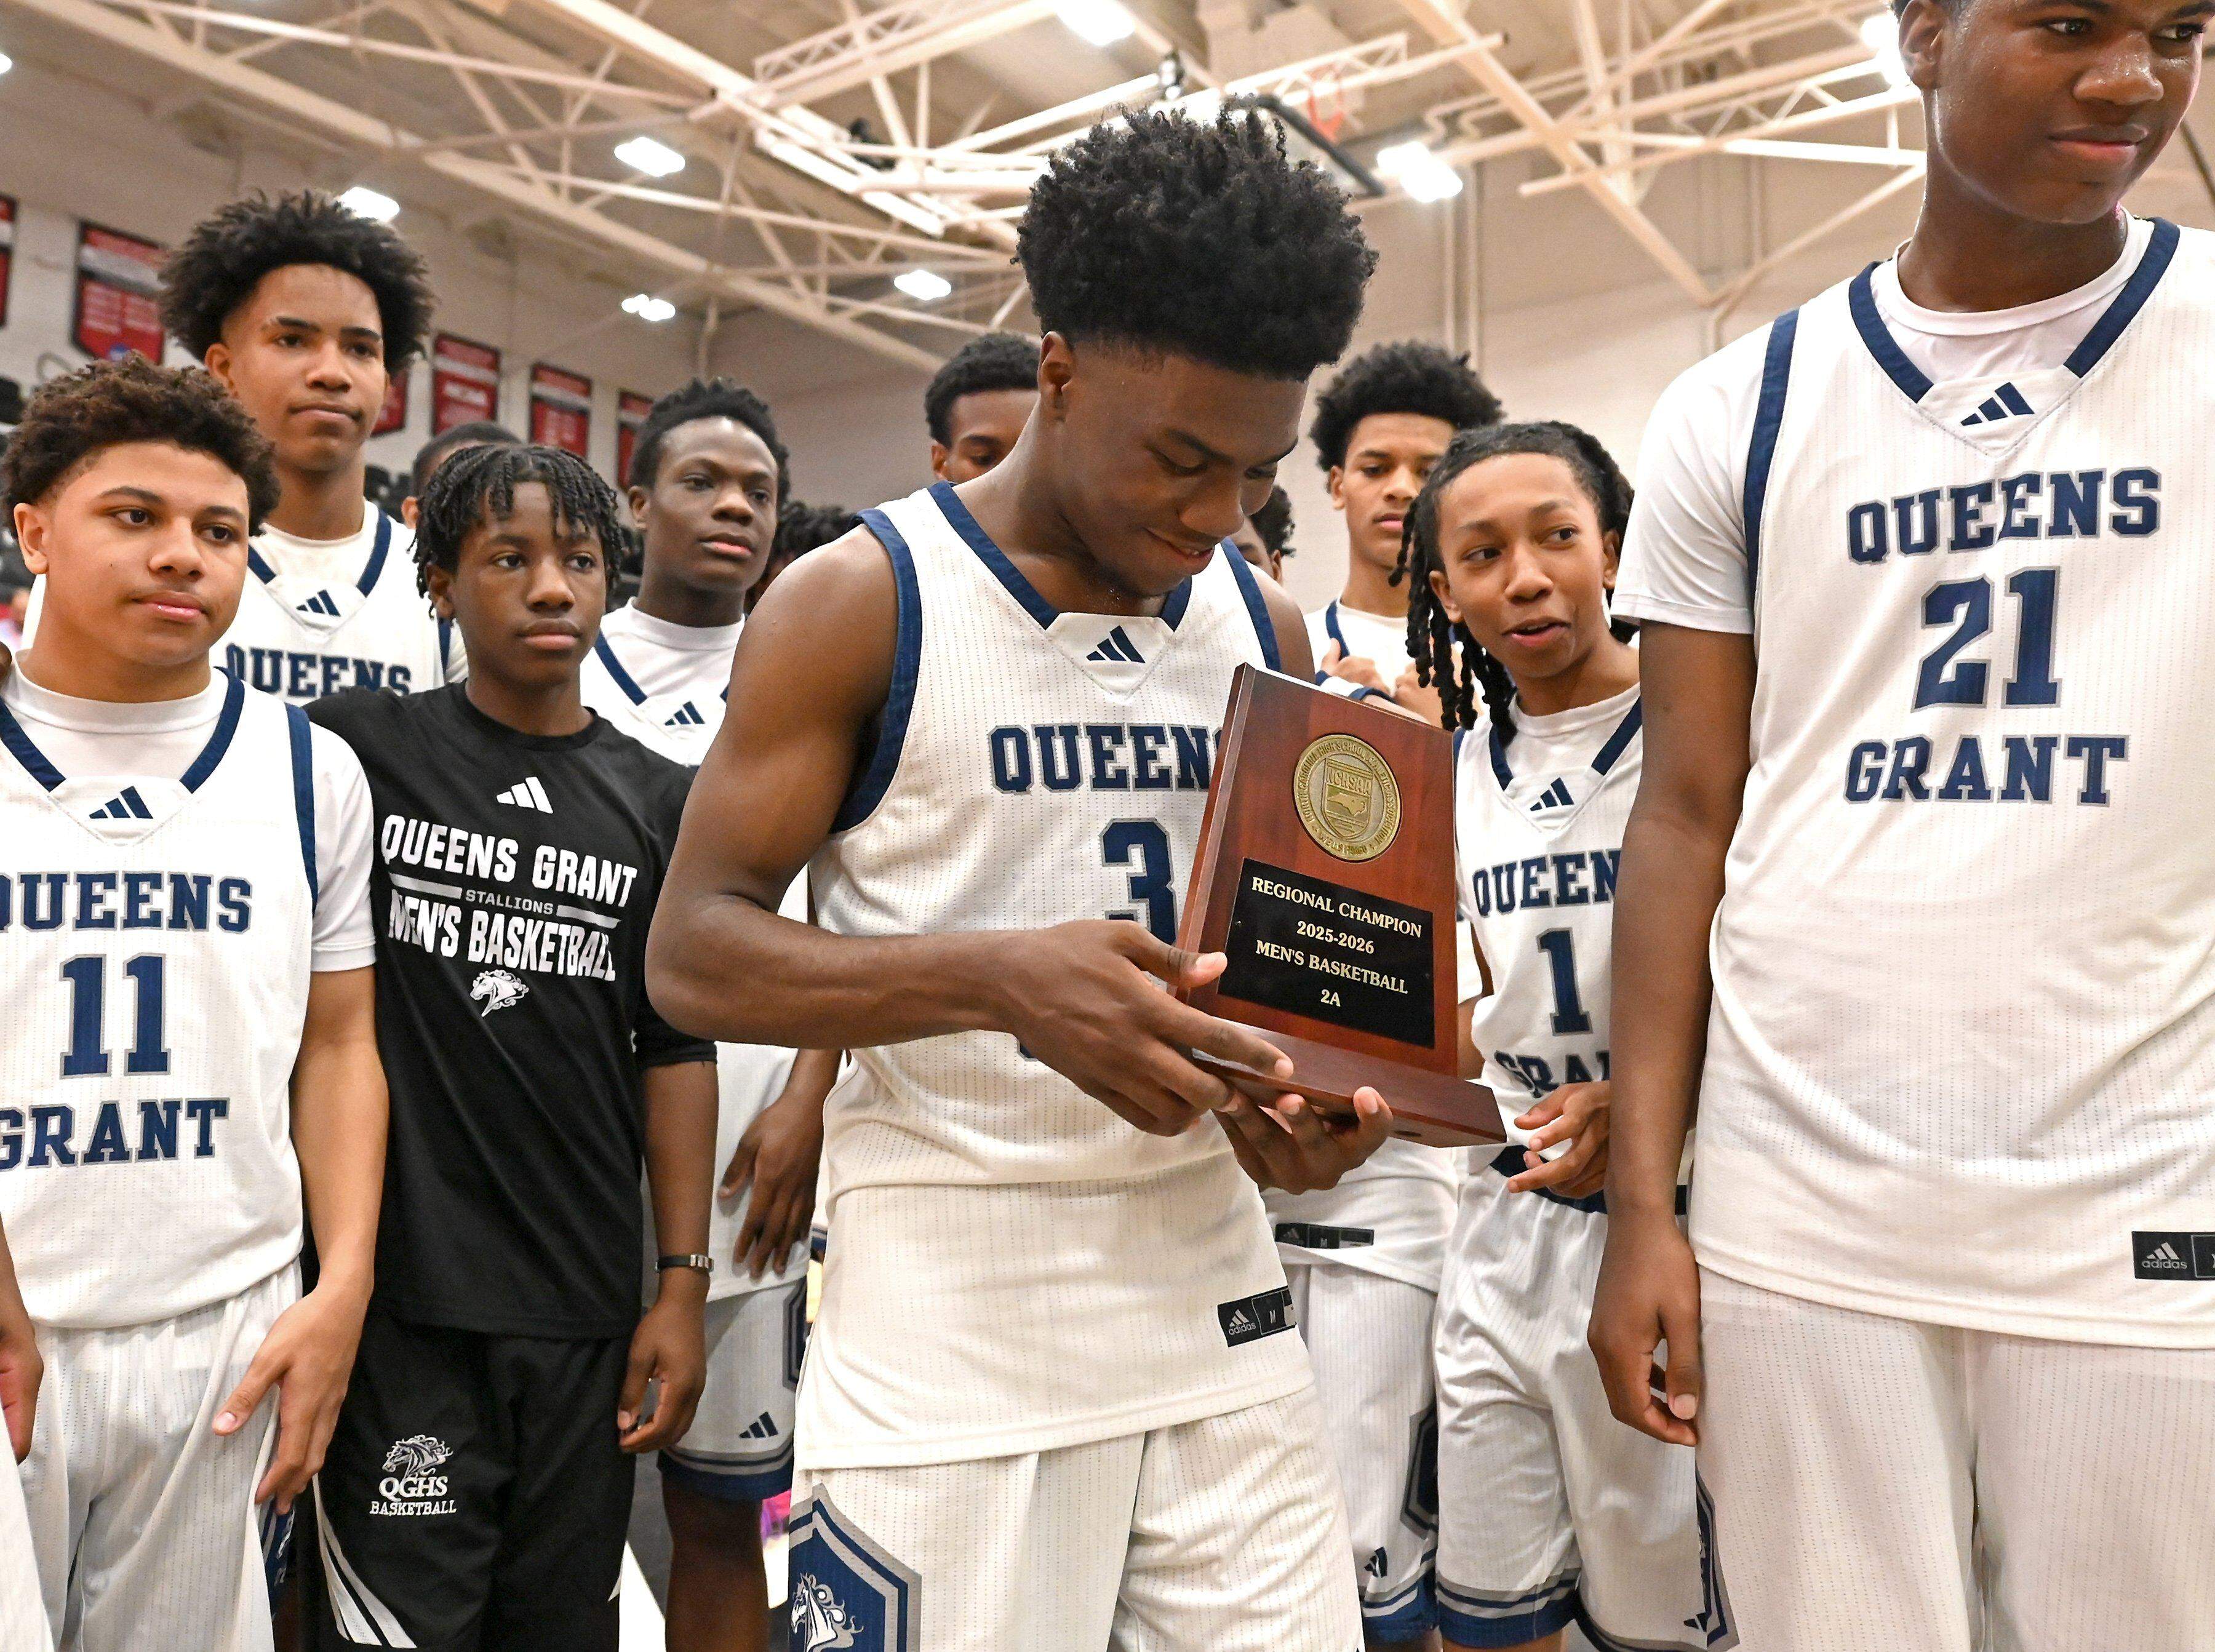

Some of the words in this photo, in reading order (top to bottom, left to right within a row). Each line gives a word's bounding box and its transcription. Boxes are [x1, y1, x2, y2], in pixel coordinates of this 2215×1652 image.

[1846, 466, 2161, 565] QUEENS
[1910, 564, 2062, 714] 21
[988, 722, 1223, 795] QUEEN
[1336, 741, 1368, 761] SCHOOL
[1843, 733, 2130, 807] GRANT
[1327, 768, 1371, 795] NCHSAA
[381, 814, 519, 883] QUEENS
[532, 844, 638, 908] GRANT
[1099, 817, 1179, 945] 3
[465, 889, 554, 916] STALLIONS
[1251, 876, 1335, 913] REGIONAL
[1338, 902, 1423, 938] CHAMPION
[388, 888, 462, 959] MEN'S
[467, 909, 616, 982] BASKETBALL
[1296, 920, 1375, 954] 2025-2026
[1256, 940, 1304, 966] MEN'S
[1308, 954, 1408, 994] BASKETBALL
[1536, 927, 1593, 1036] 1
[59, 952, 172, 1079] 11
[1320, 989, 1341, 1007] 2A
[2142, 1259, 2187, 1269] adidas
[1228, 1322, 1256, 1336] adidas
[369, 1500, 457, 1517] BASKETBALL
[378, 1476, 449, 1502] QGHS
